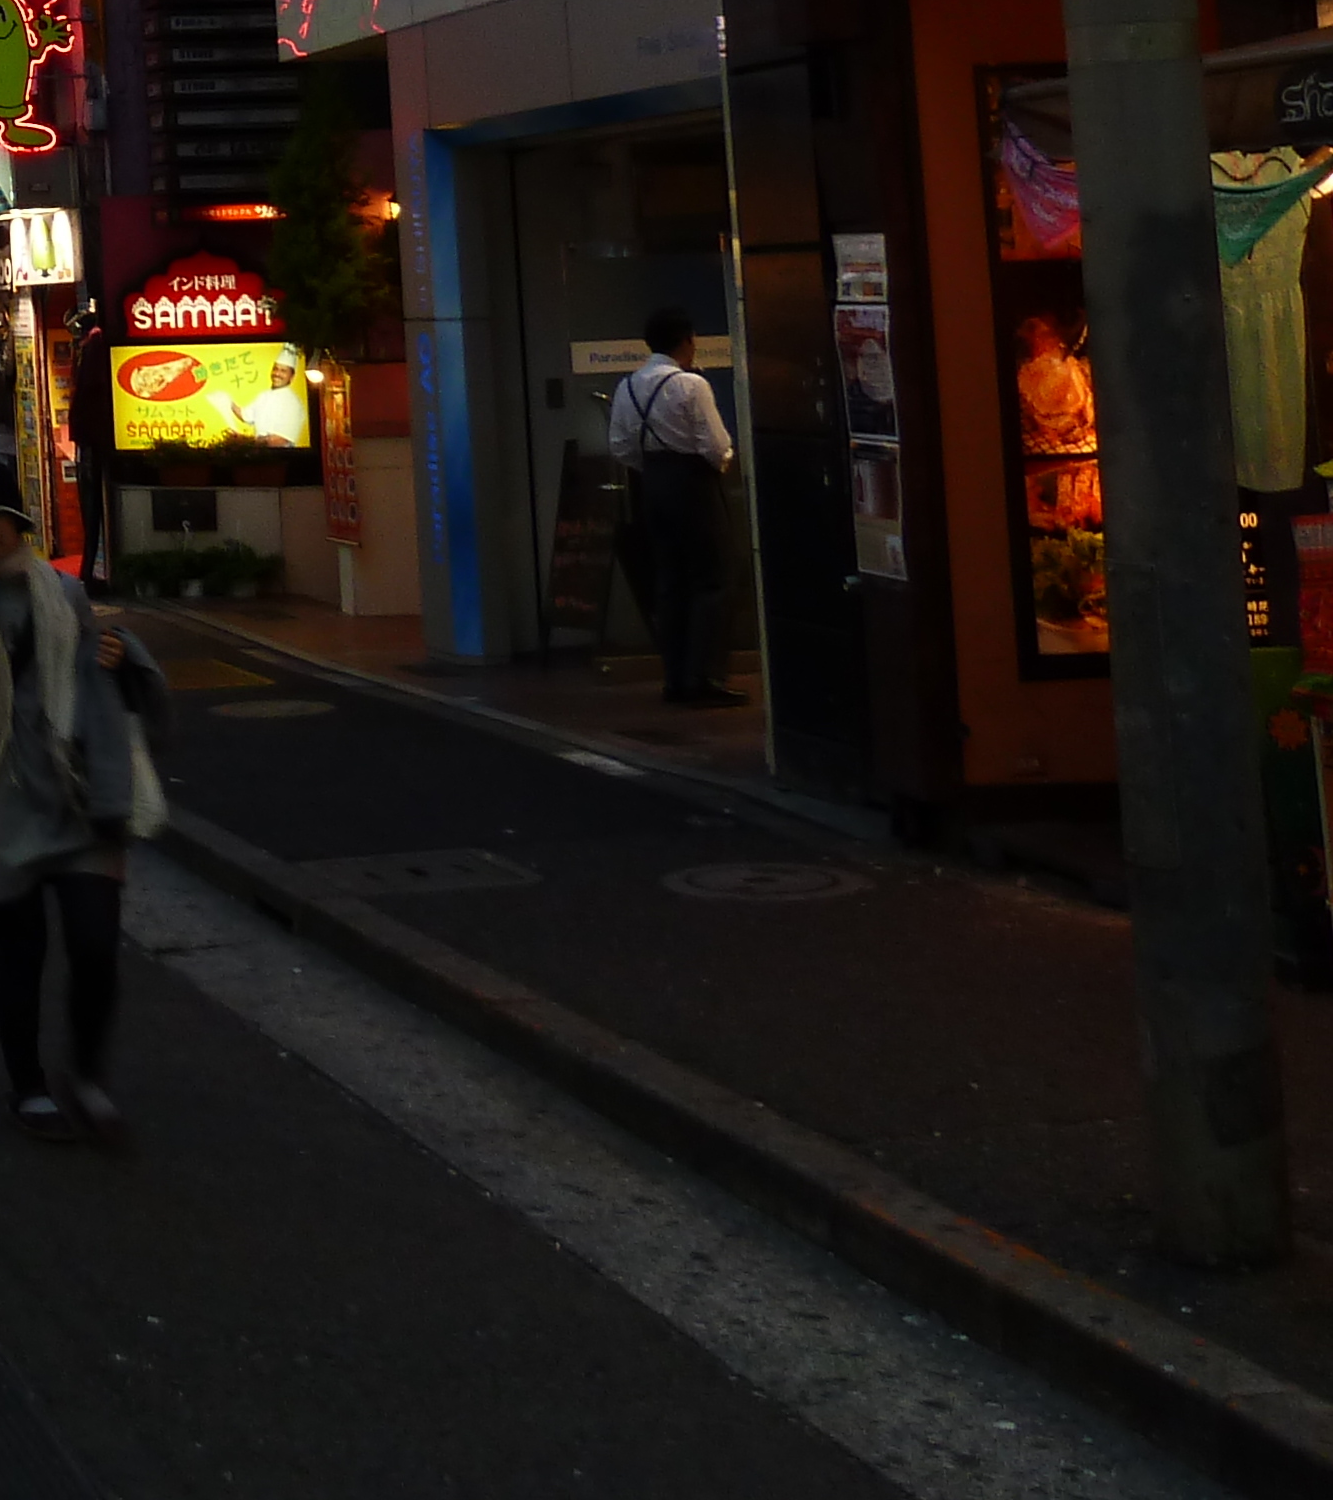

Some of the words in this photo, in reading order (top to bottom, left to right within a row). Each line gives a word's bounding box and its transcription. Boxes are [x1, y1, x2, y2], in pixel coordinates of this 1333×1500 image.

[168, 273, 236, 292] インド料理
[131, 294, 279, 330] SAMRAT
[126, 420, 205, 439] SAMRAT
